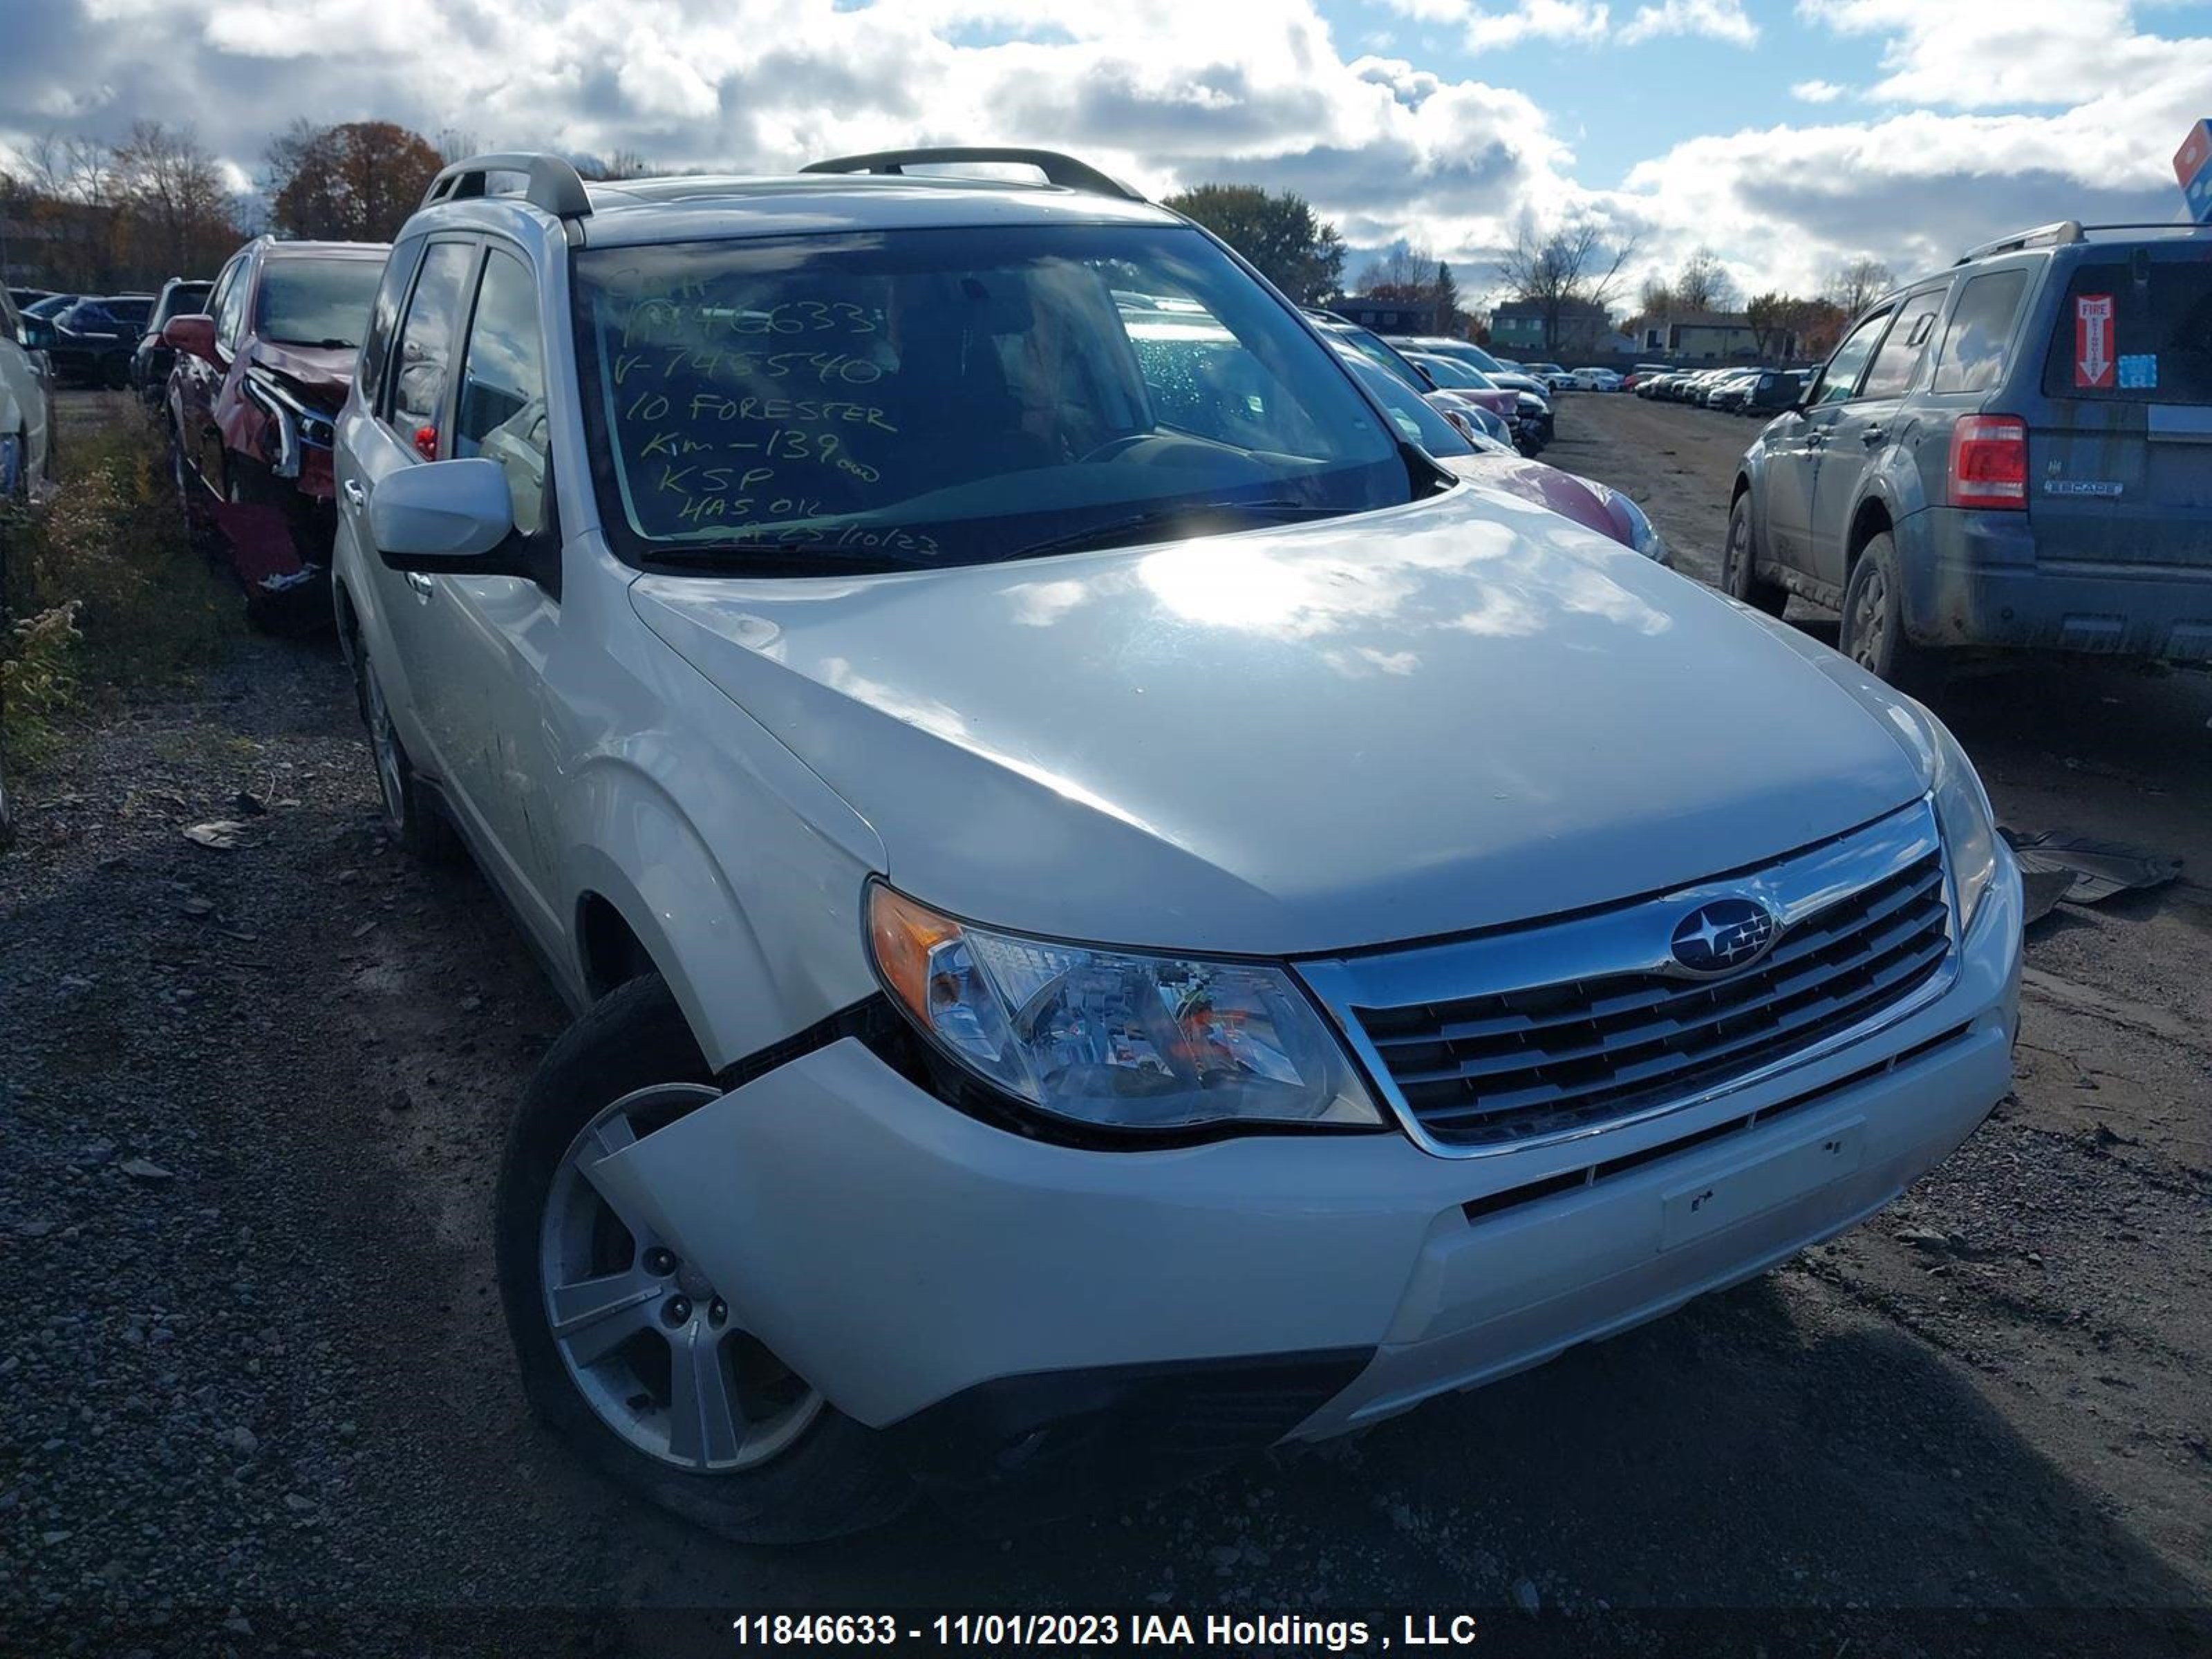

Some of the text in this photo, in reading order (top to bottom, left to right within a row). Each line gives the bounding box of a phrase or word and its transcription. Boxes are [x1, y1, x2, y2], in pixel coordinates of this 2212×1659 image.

[2082, 303, 2108, 316] FIRE
[626, 391, 899, 432] 10 FORESTER
